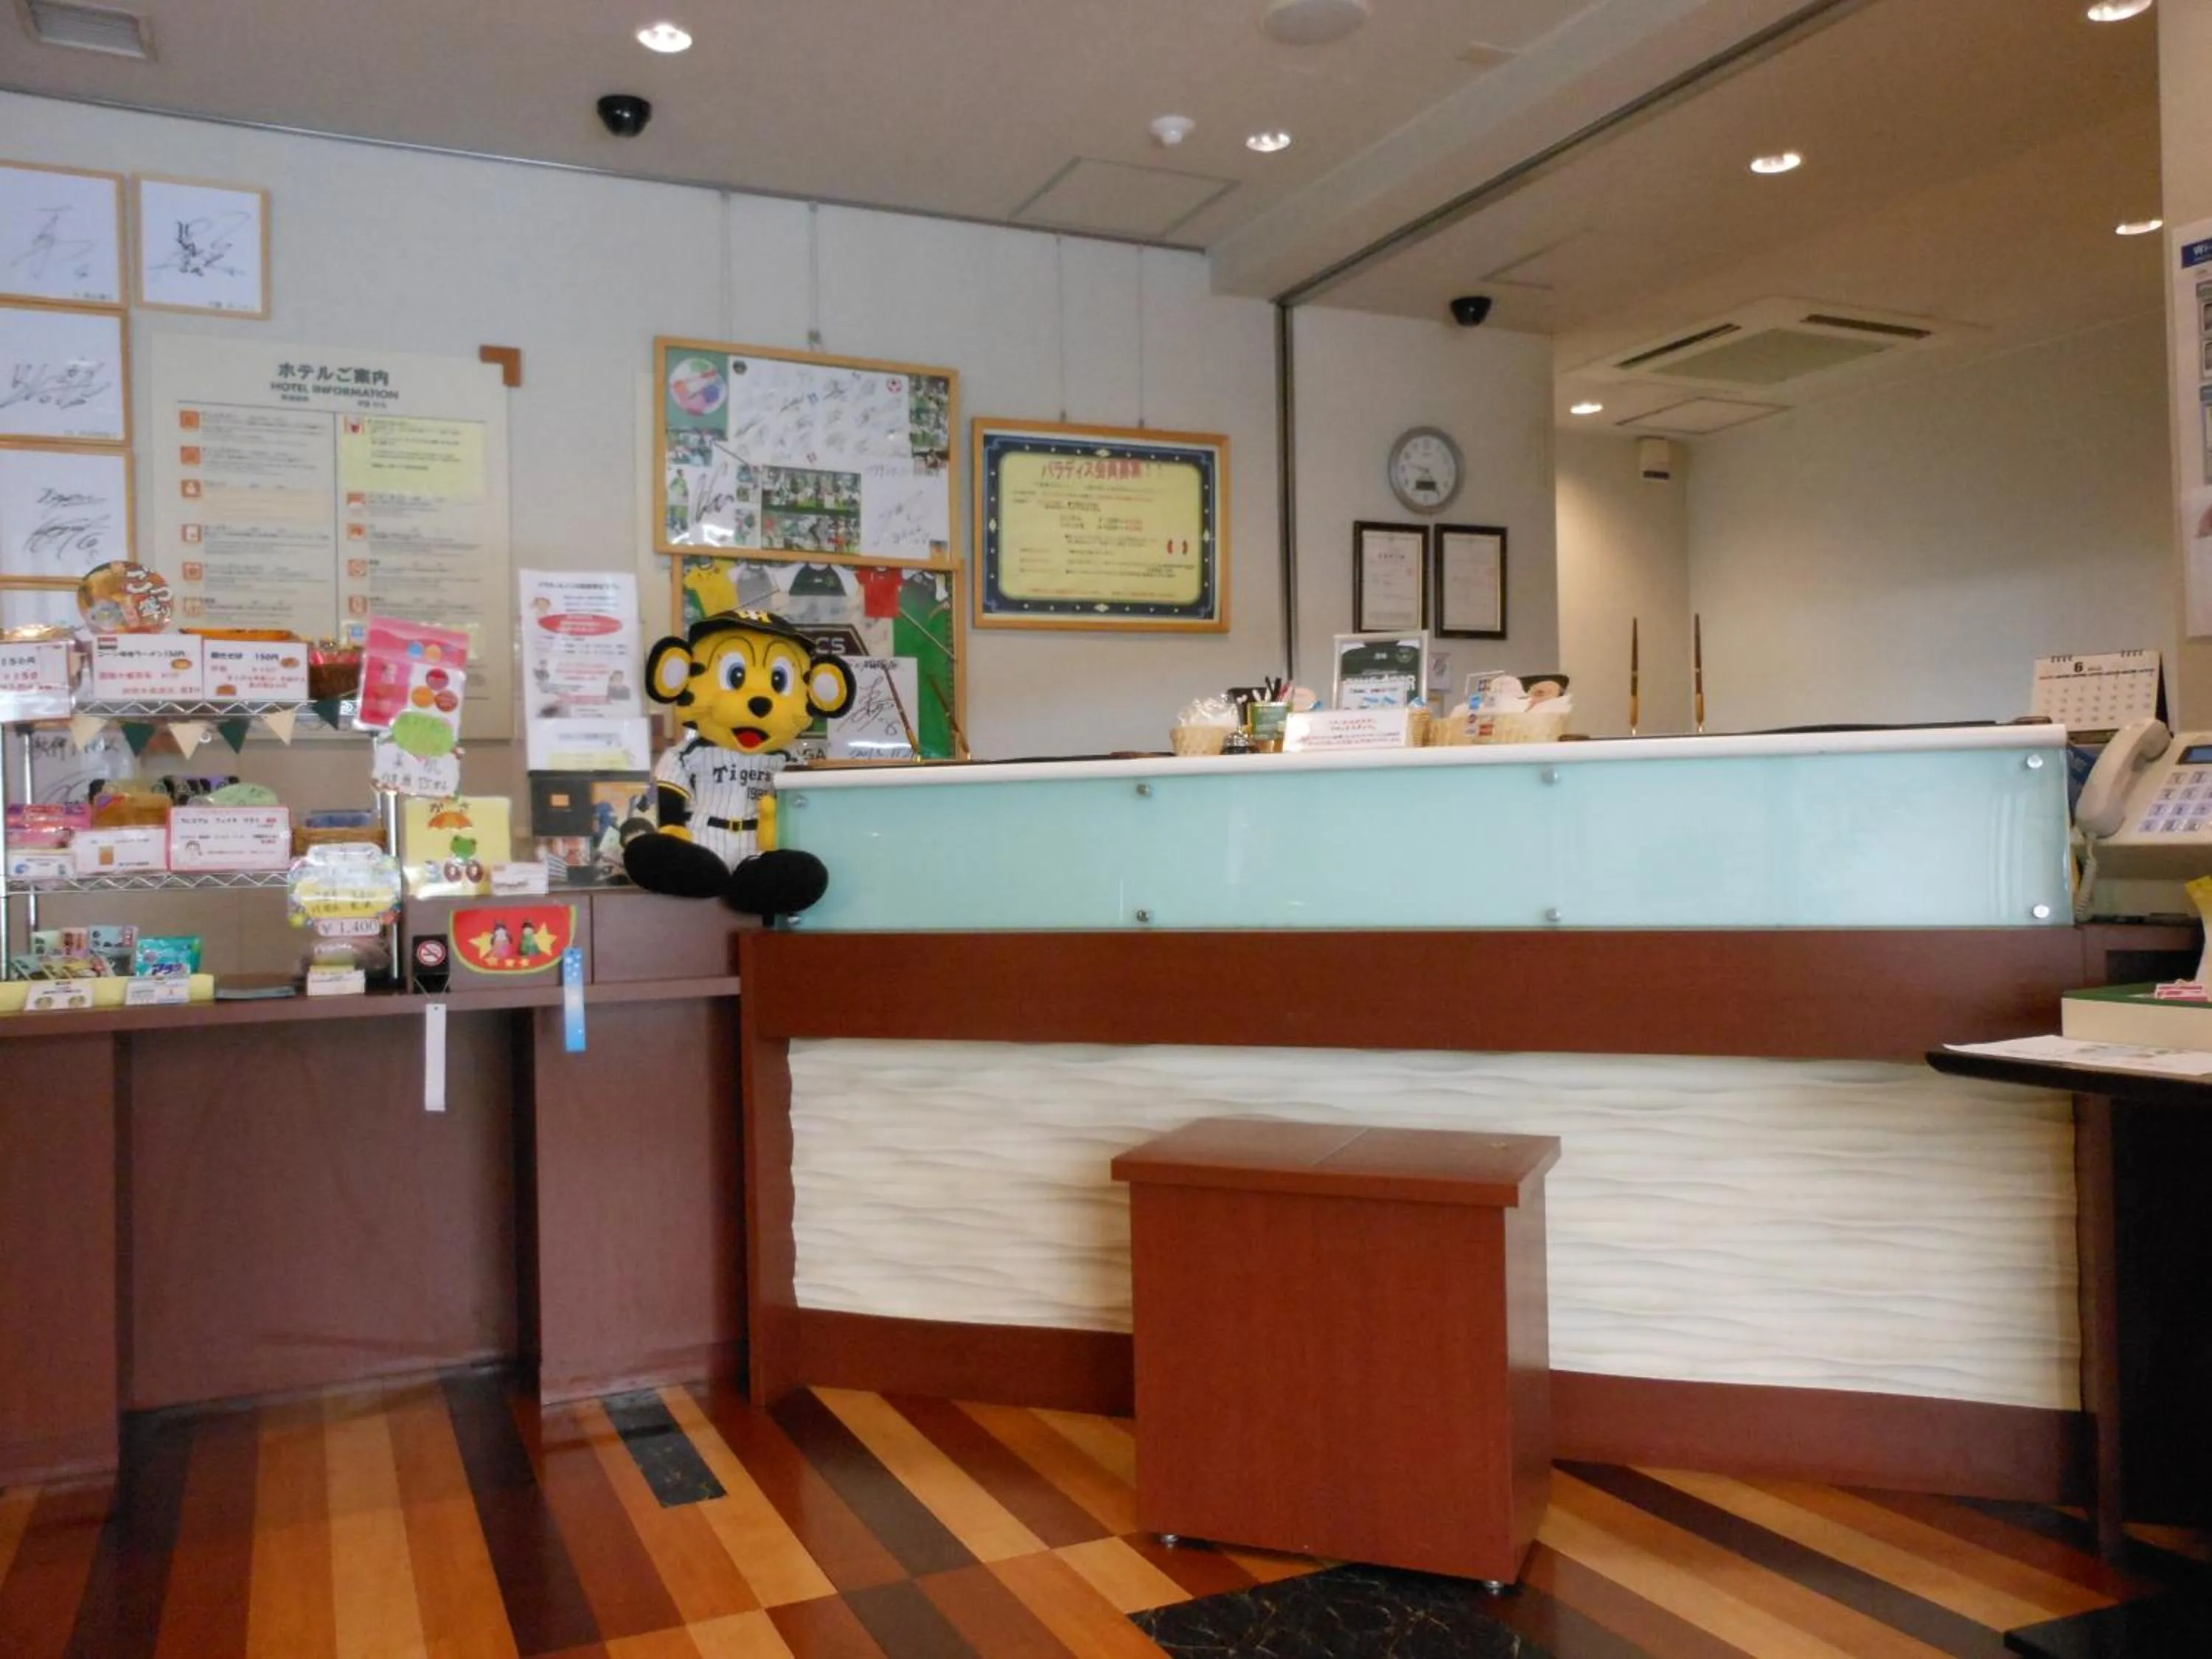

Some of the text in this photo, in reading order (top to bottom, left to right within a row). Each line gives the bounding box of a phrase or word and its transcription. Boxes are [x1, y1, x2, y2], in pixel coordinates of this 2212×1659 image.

[278, 361, 389, 386] ホテルご案内
[271, 382, 309, 394] HOTEL
[312, 384, 400, 400] INFORMATION
[2073, 661, 2084, 673] 6
[712, 764, 773, 786] Tigers
